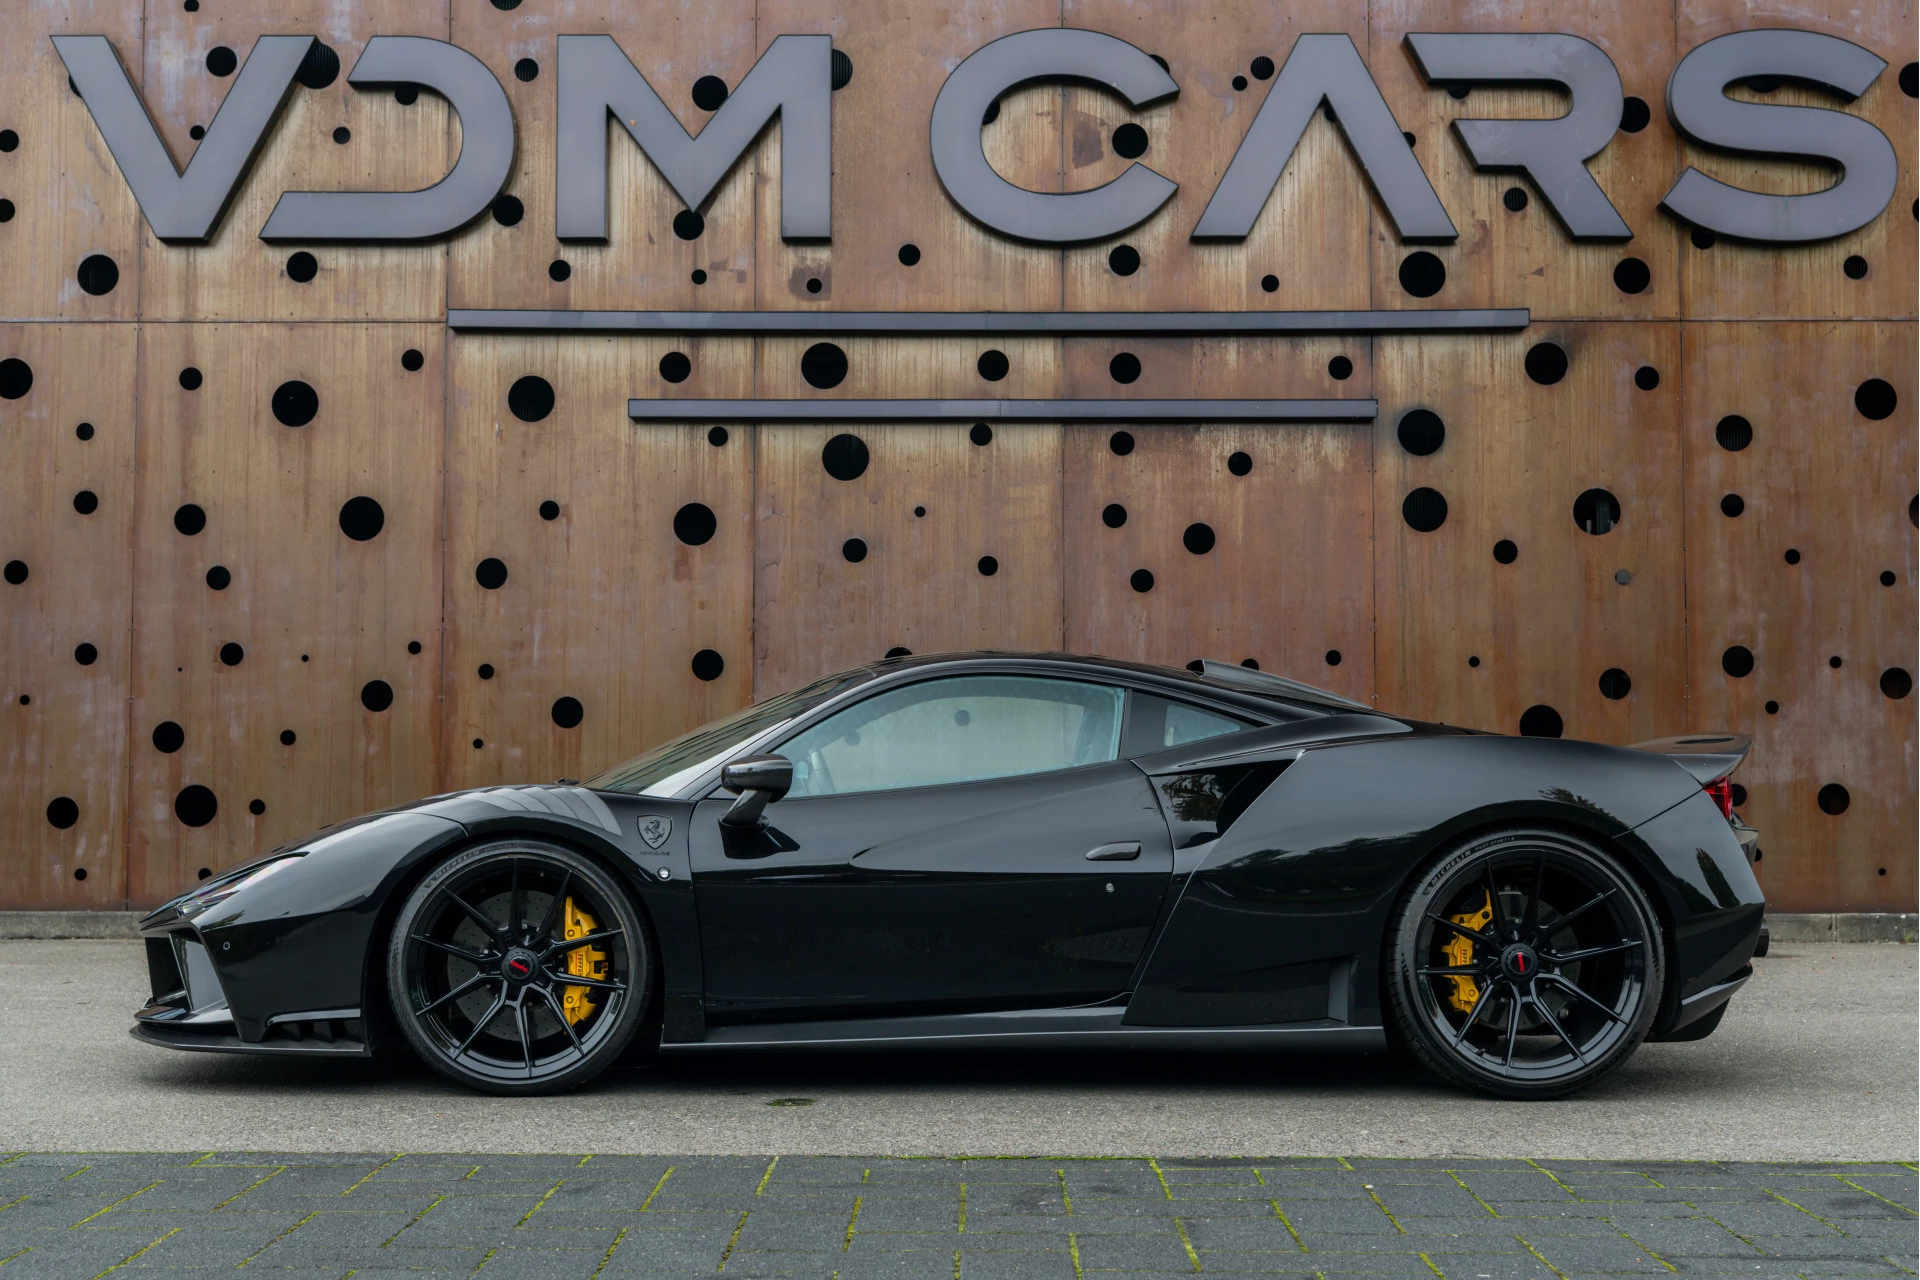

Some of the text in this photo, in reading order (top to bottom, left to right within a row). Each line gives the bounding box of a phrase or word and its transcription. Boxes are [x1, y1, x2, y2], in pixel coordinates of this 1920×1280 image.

[49, 28, 1899, 243] VDM CARS
[434, 849, 480, 879] MICHELIN
[1431, 849, 1472, 886] MICHELIN
